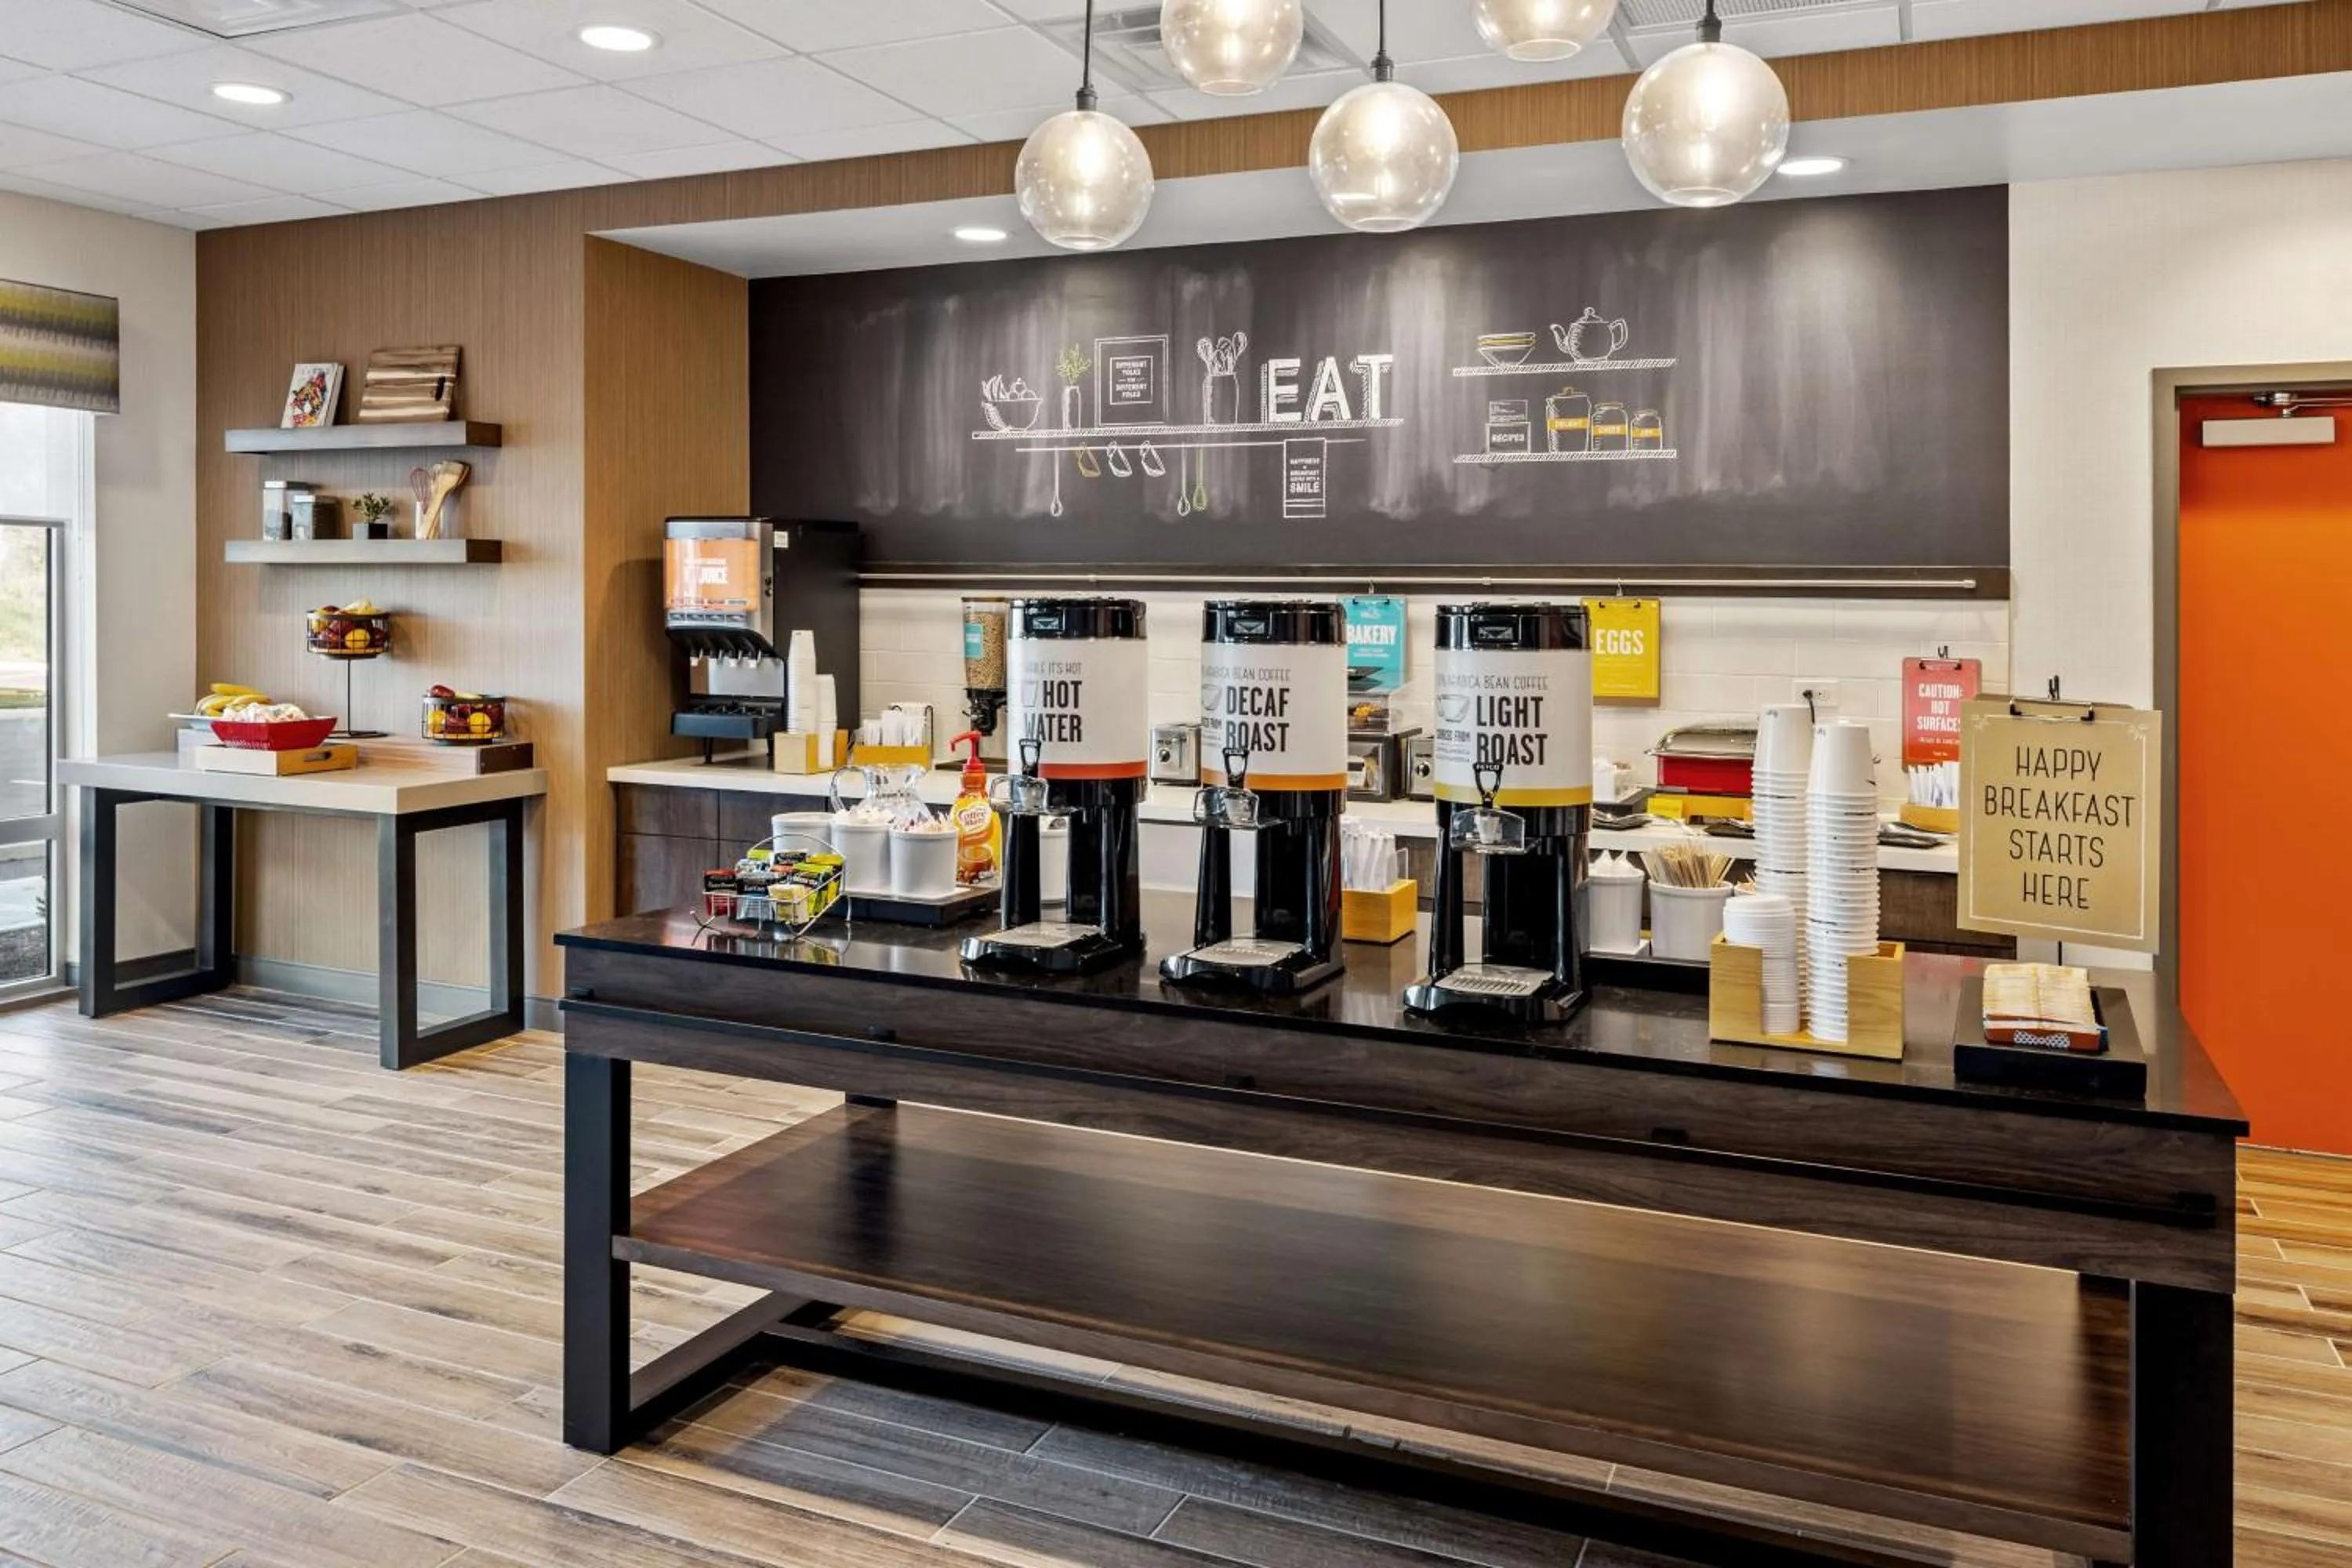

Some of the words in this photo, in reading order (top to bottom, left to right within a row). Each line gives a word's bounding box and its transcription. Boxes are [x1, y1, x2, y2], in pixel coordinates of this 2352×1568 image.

[1260, 354, 1393, 423] EAT
[1290, 482, 1320, 493] SMILE
[1346, 624, 1396, 645] BAKERY
[1595, 628, 1644, 655] EGGS
[1042, 680, 1083, 709] HOT
[1484, 675, 1509, 690] BEAN
[1514, 675, 1548, 691] COFFEE
[1226, 685, 1290, 717] DECAF
[1476, 695, 1544, 728] LIGHT
[1930, 700, 1951, 715] HOT
[1024, 713, 1082, 742] WATER
[1225, 720, 1290, 753] ROAST
[1476, 732, 1548, 766] ROAST
[2016, 746, 2102, 782] HAPPY
[1984, 785, 2136, 828] BREAKFAST
[2009, 829, 2104, 868] STARTS
[2023, 872, 2089, 910] HERE
